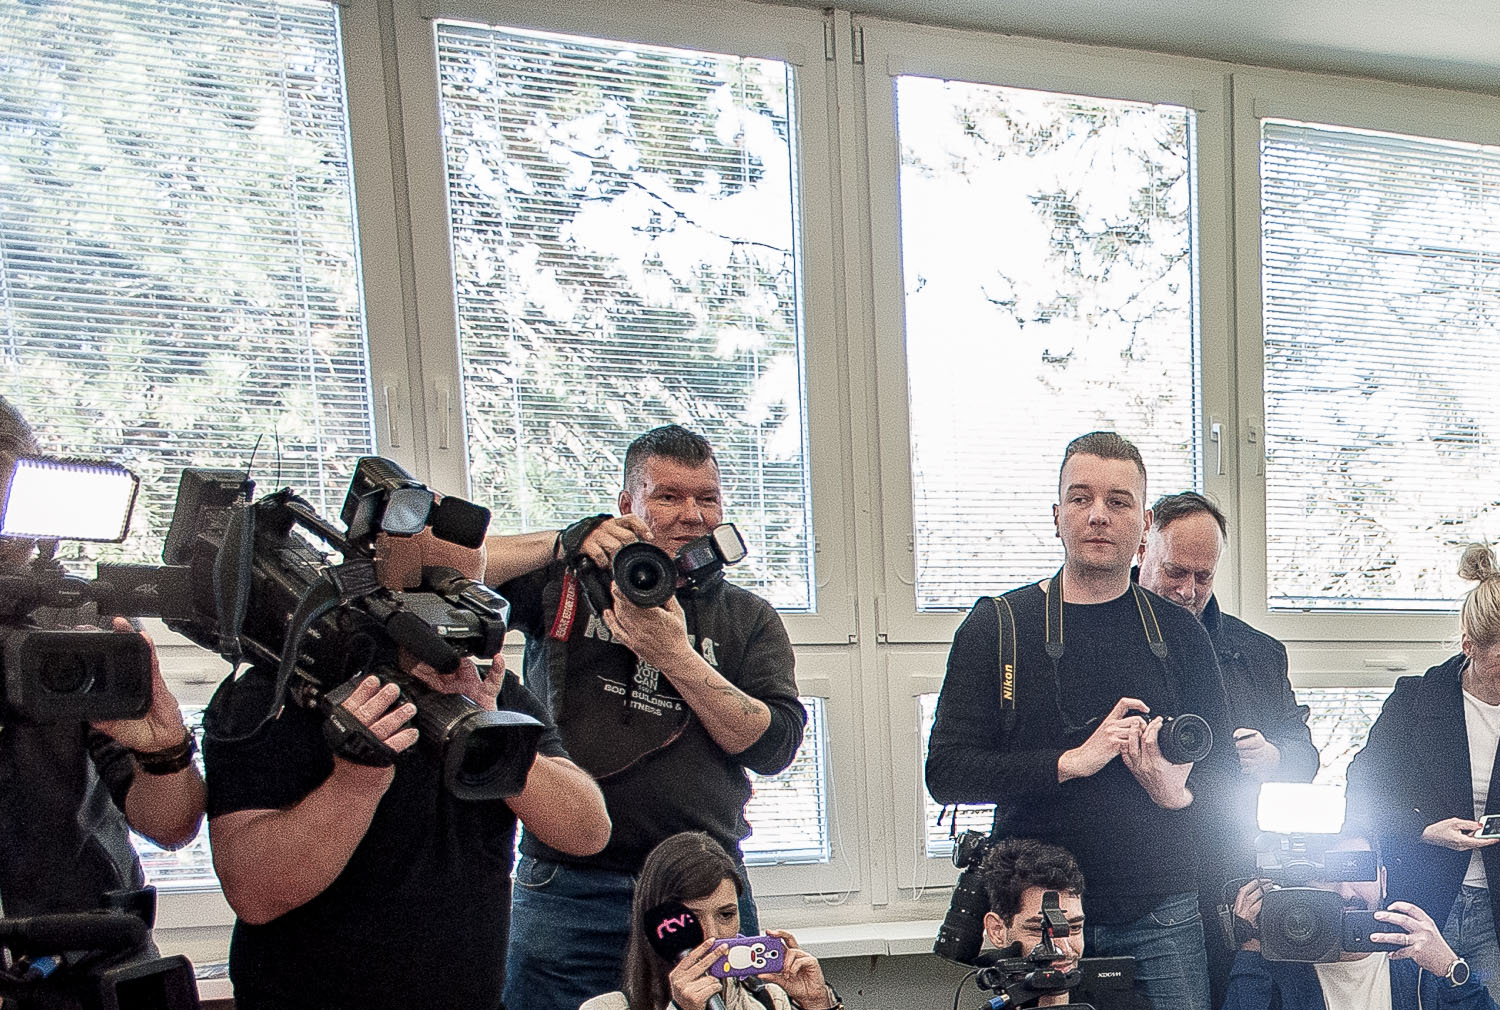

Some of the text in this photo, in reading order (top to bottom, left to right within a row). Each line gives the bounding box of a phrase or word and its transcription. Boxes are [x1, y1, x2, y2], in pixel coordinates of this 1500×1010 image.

[636, 664, 659, 680] YOU
[634, 674, 658, 691] CAN
[1003, 664, 1013, 700] Nikon
